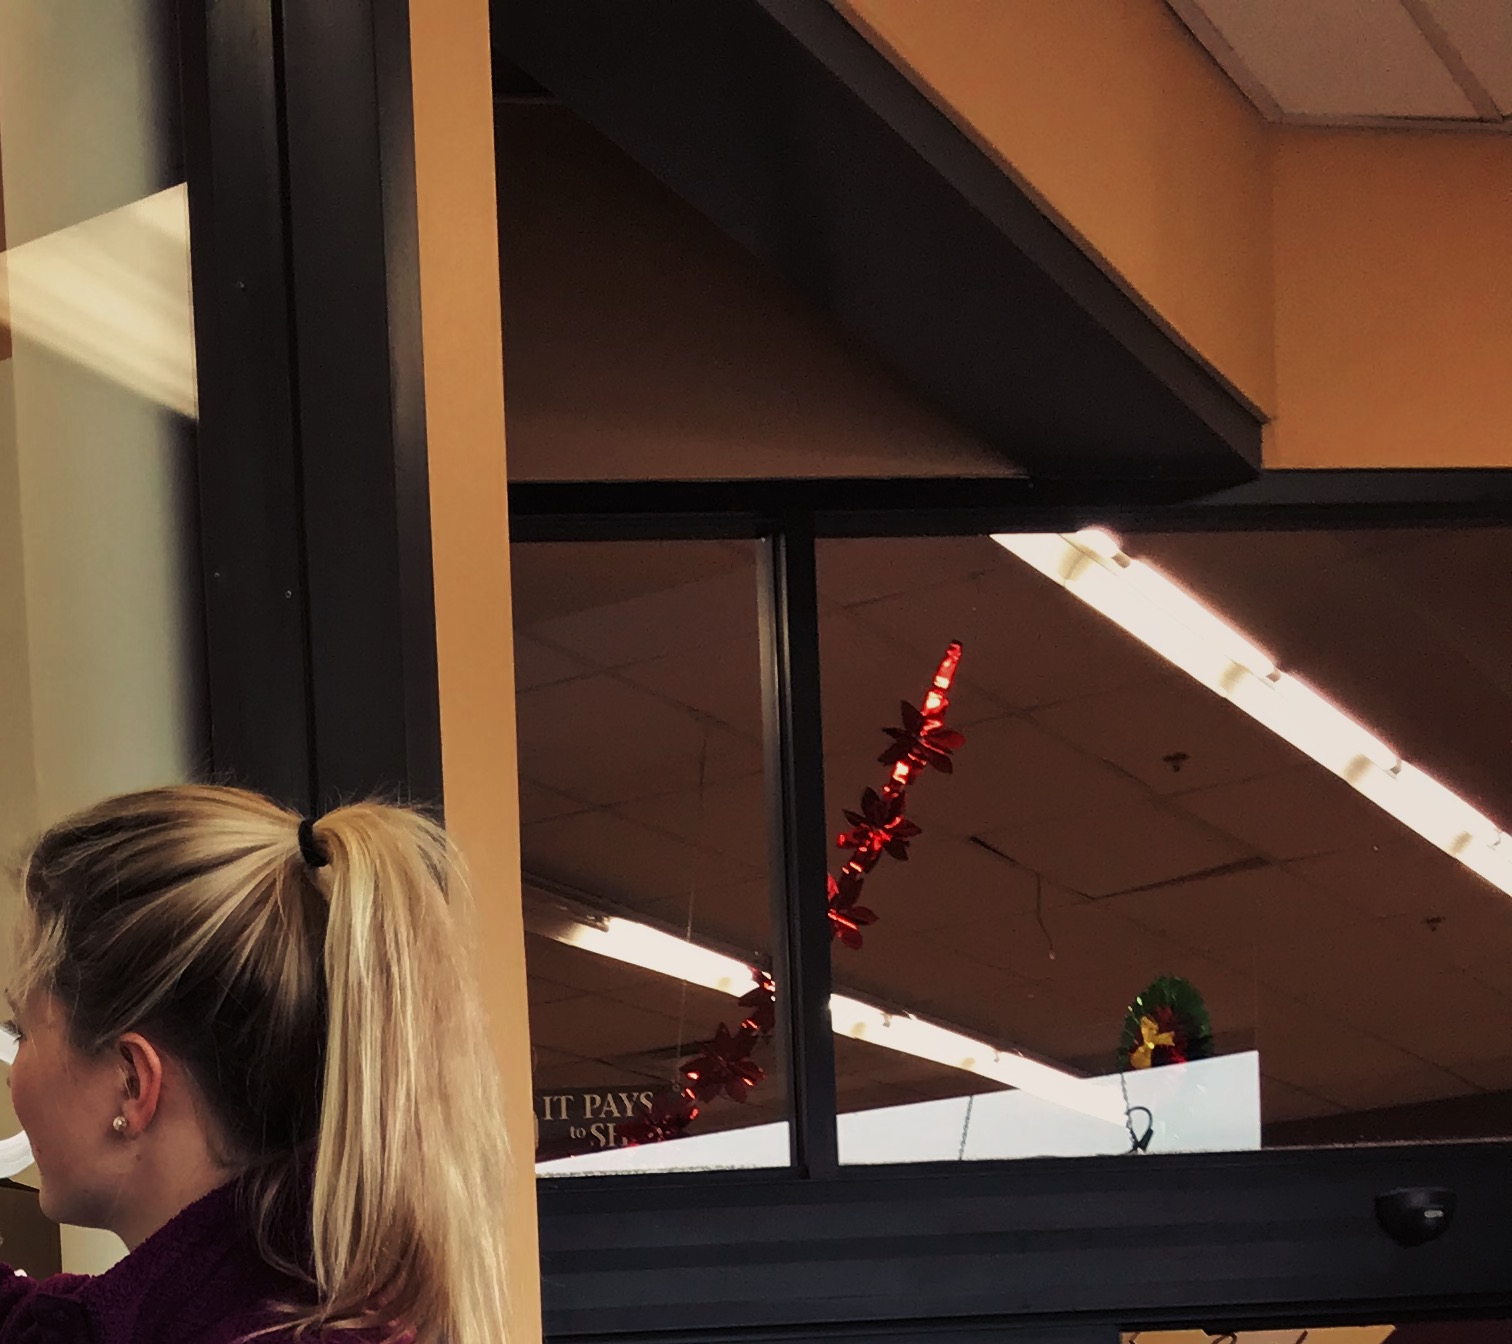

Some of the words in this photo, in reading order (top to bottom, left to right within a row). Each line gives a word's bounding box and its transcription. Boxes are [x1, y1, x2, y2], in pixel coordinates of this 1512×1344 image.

[543, 1095, 573, 1120] IT
[583, 1091, 654, 1119] PAYS
[570, 1126, 586, 1139] to
